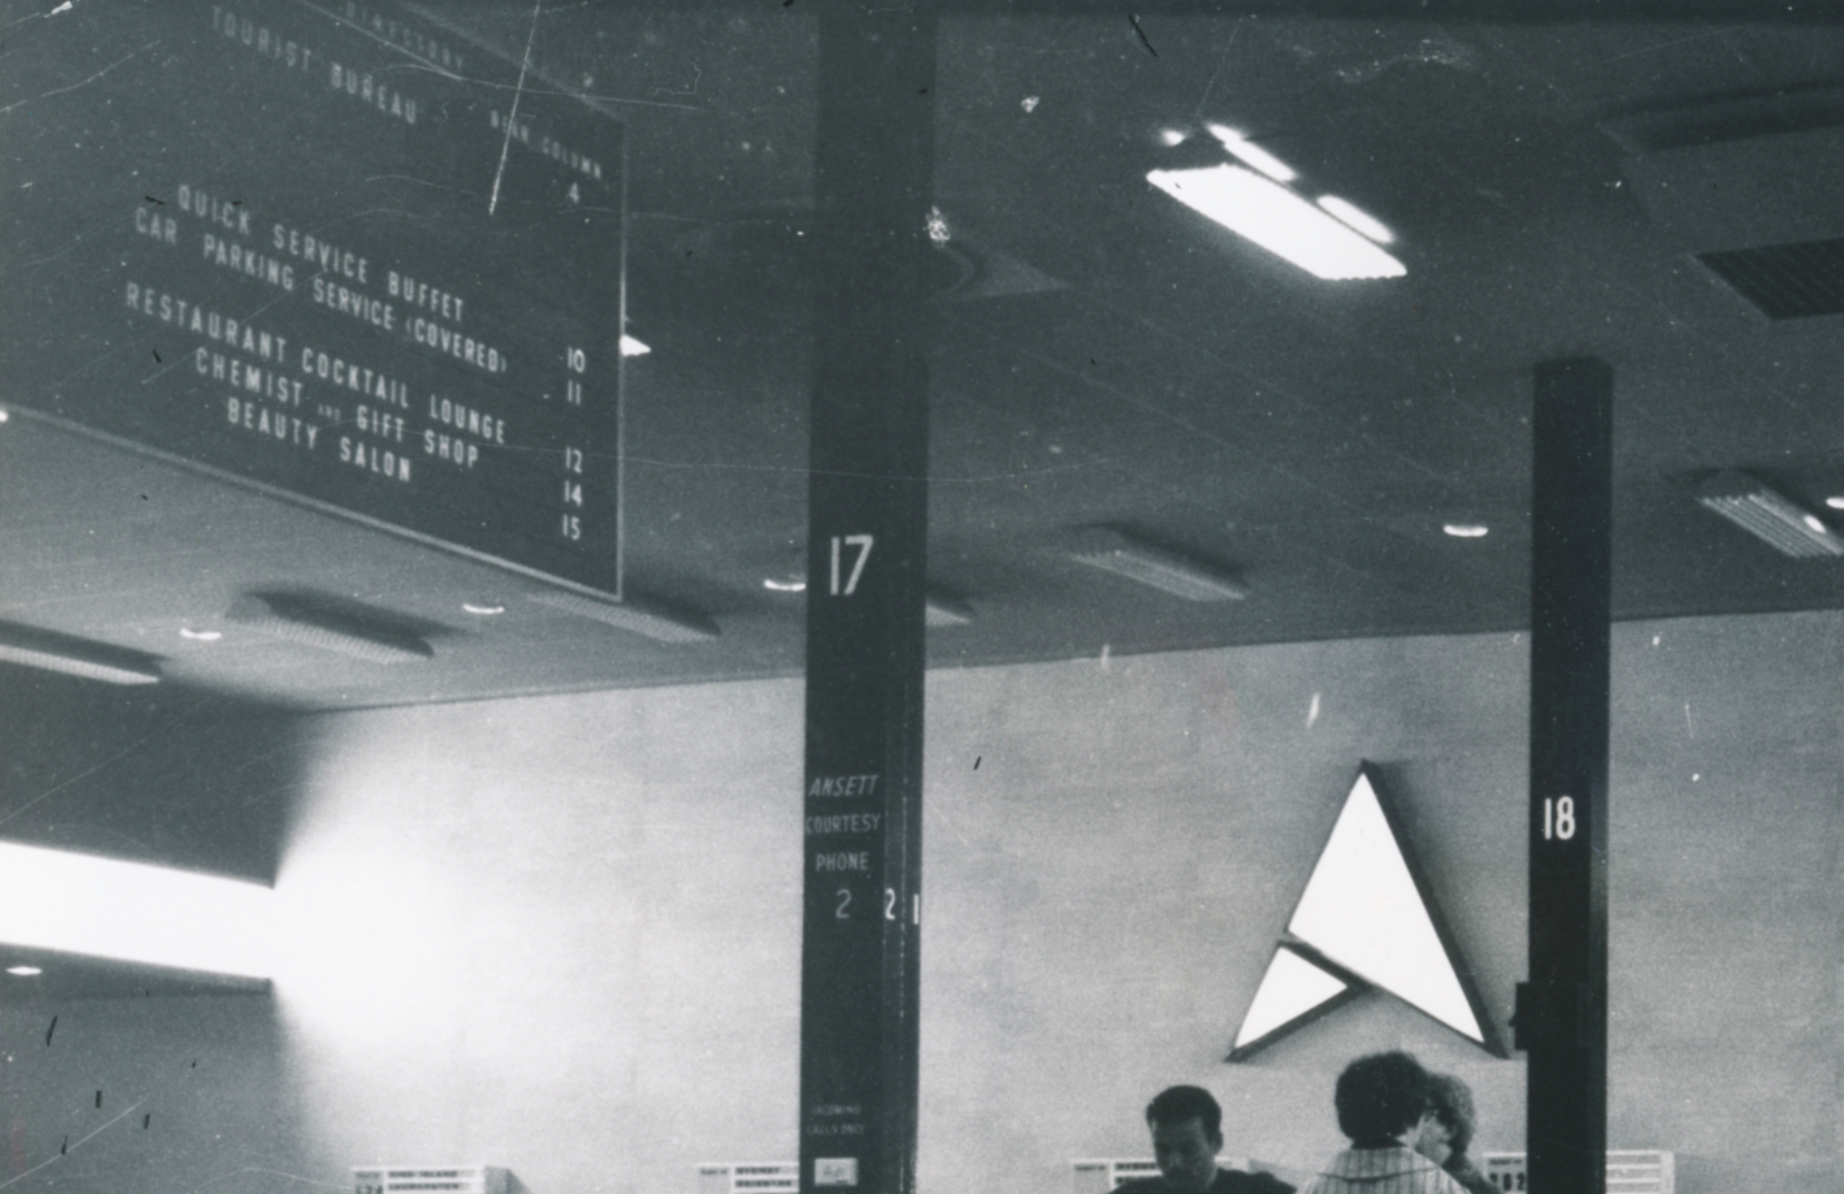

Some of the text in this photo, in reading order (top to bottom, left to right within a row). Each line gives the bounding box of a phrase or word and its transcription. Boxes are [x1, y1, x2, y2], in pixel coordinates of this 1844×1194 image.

[211, 7, 416, 124] TOURIST BUREAU
[178, 184, 463, 322] QUICK SERVICE BUFFET
[136, 207, 506, 373] CAR PARKING SERVICE (COVERED)
[127, 281, 505, 443] RESTAURANT COCKTAIL LOUNGE
[567, 346, 586, 373] 10
[196, 347, 302, 407] CHEMIST
[356, 405, 404, 442] GIFT
[425, 429, 479, 468] SHOP
[567, 379, 582, 405] 11
[228, 396, 410, 482] BEAUTY SALON
[565, 446, 583, 474] 12
[564, 480, 583, 506] 14
[563, 514, 580, 541] 15
[829, 534, 875, 596] 17
[809, 774, 878, 797] ANSETT
[805, 813, 880, 834] COURTESY
[1544, 795, 1576, 840] 18
[816, 852, 870, 871] PHONE
[835, 888, 851, 919] 2
